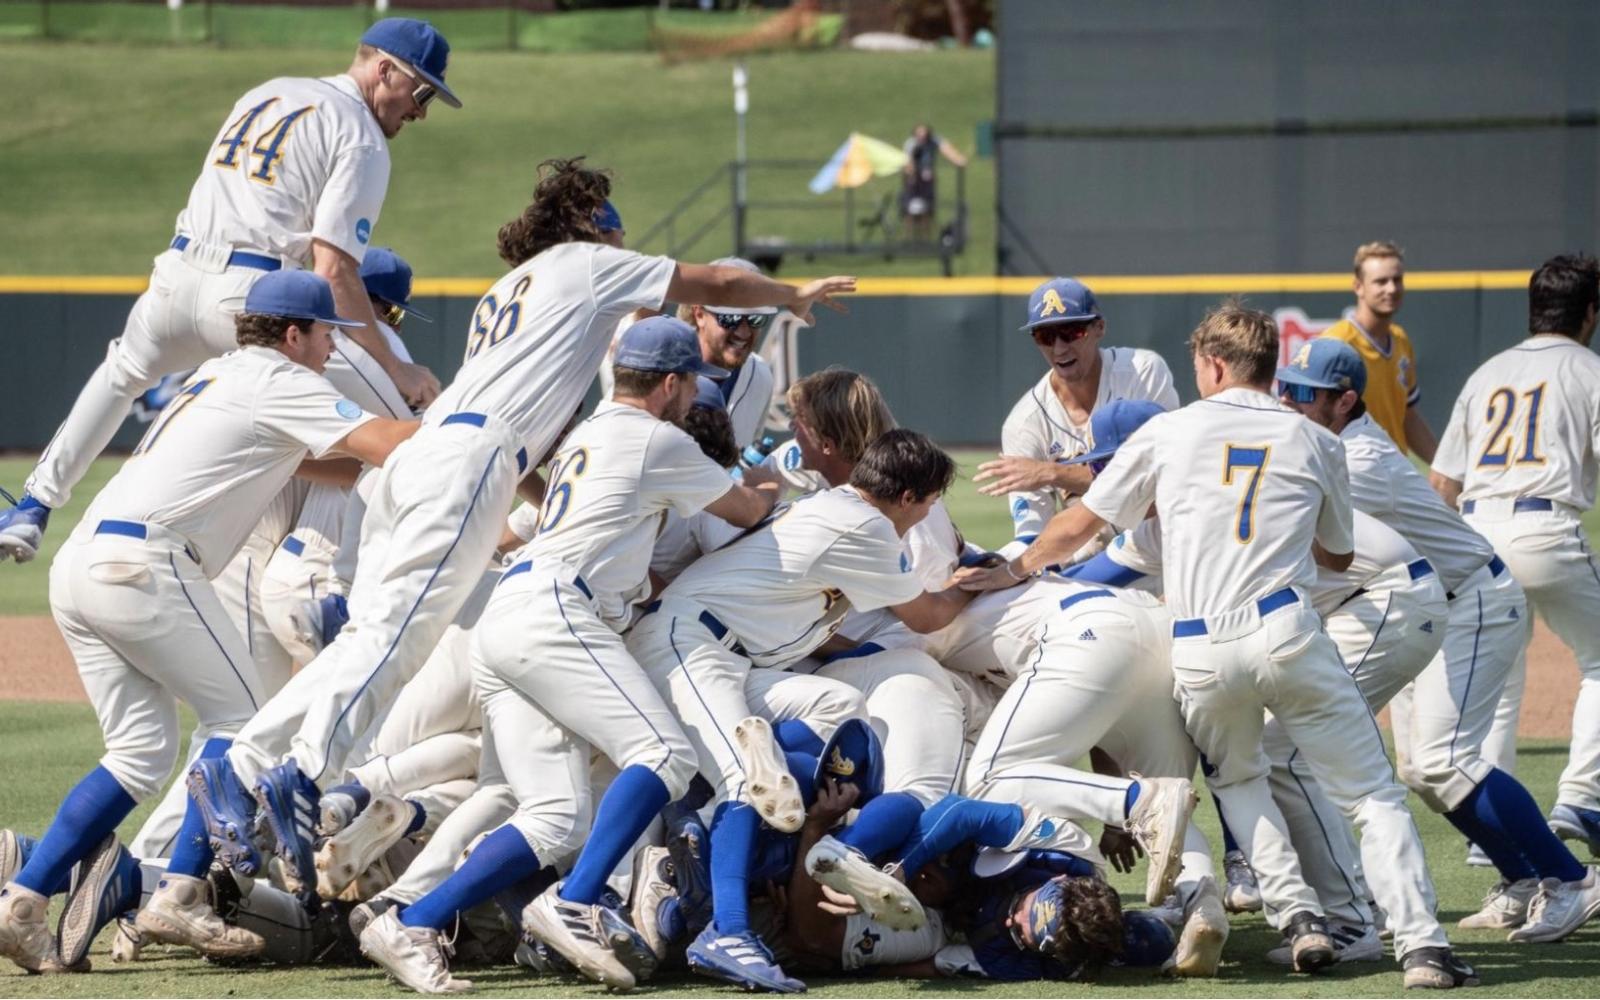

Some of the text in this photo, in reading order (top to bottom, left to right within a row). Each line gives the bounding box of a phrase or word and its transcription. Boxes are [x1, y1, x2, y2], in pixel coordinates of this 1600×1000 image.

[214, 96, 315, 185] 44
[1041, 288, 1067, 318] A
[1476, 381, 1547, 470] 21
[1223, 443, 1271, 544] 7
